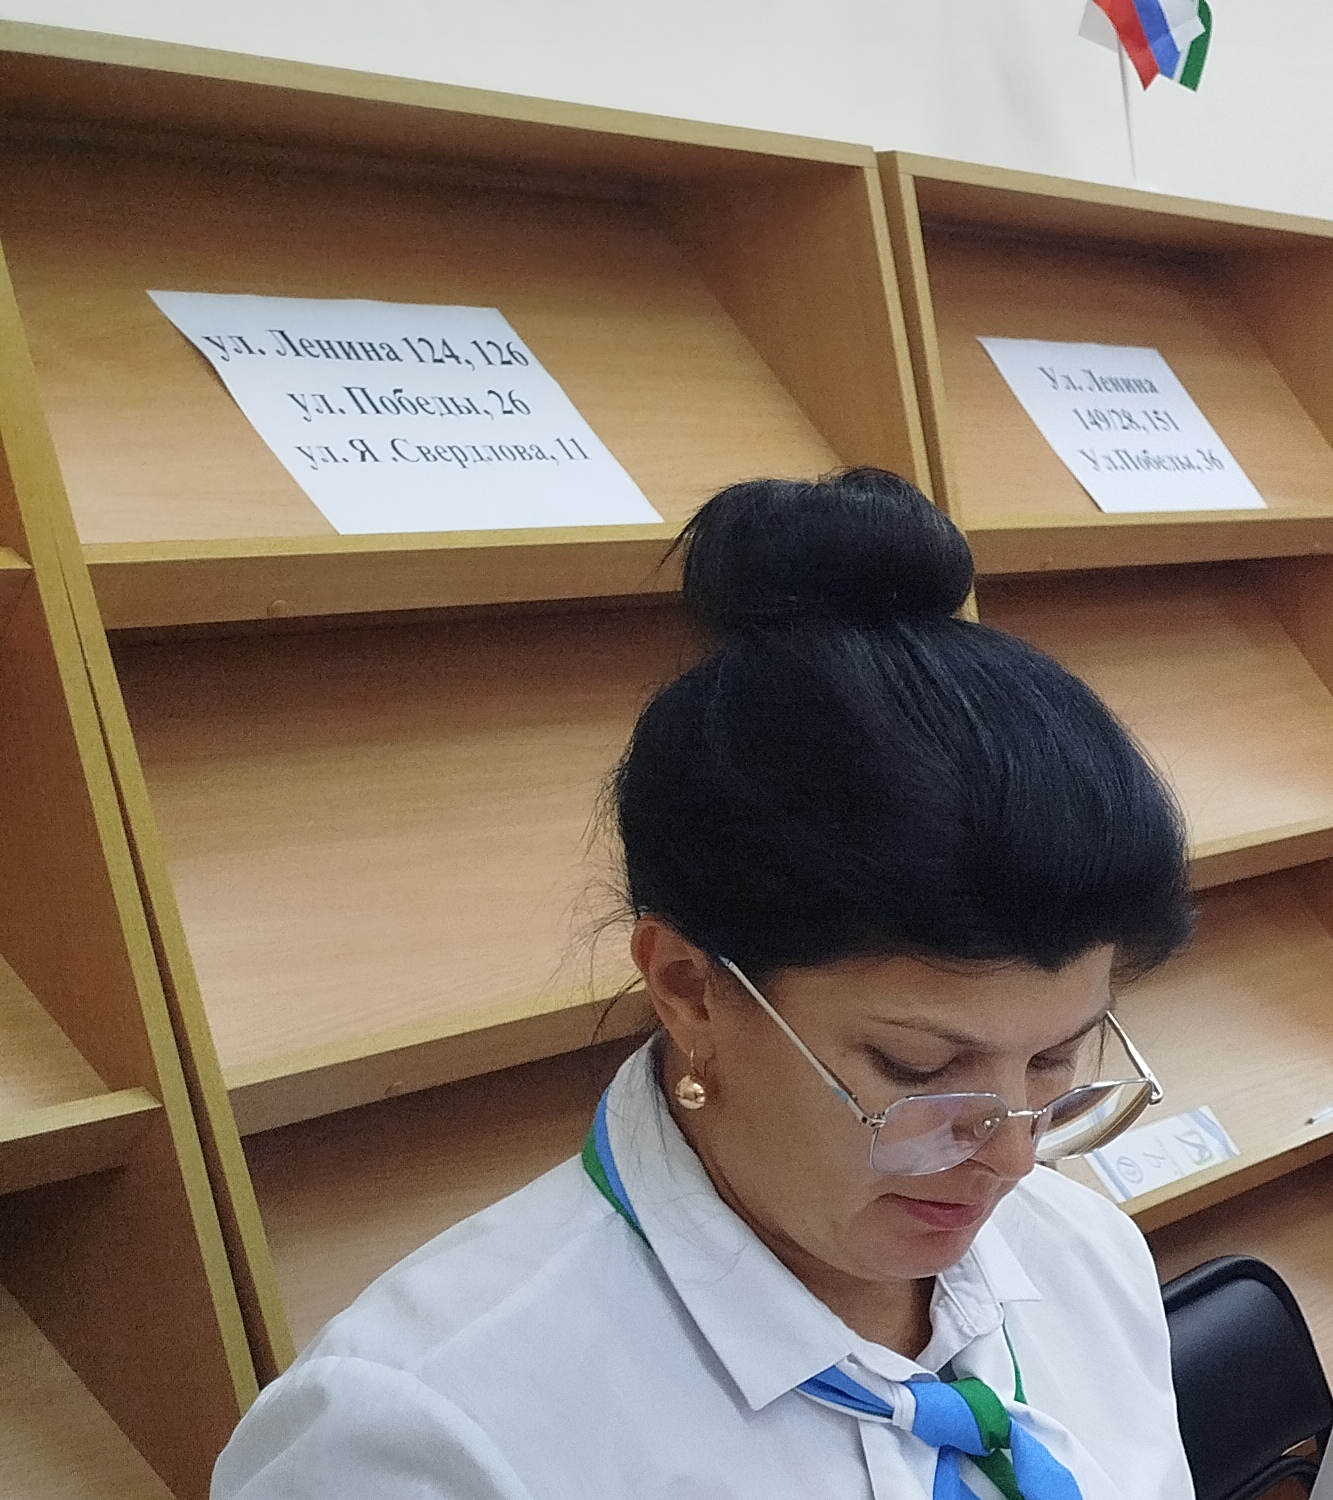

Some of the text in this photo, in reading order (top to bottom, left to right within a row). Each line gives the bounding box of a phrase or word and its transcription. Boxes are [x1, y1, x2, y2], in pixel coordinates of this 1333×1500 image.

[202, 329, 530, 372] ул. Ленина 124, 126
[1081, 369, 1159, 395] Ленина
[286, 386, 532, 422] ул. Победы, 26
[295, 443, 348, 471] ул.
[348, 439, 380, 464] Я
[554, 438, 591, 461] 11
